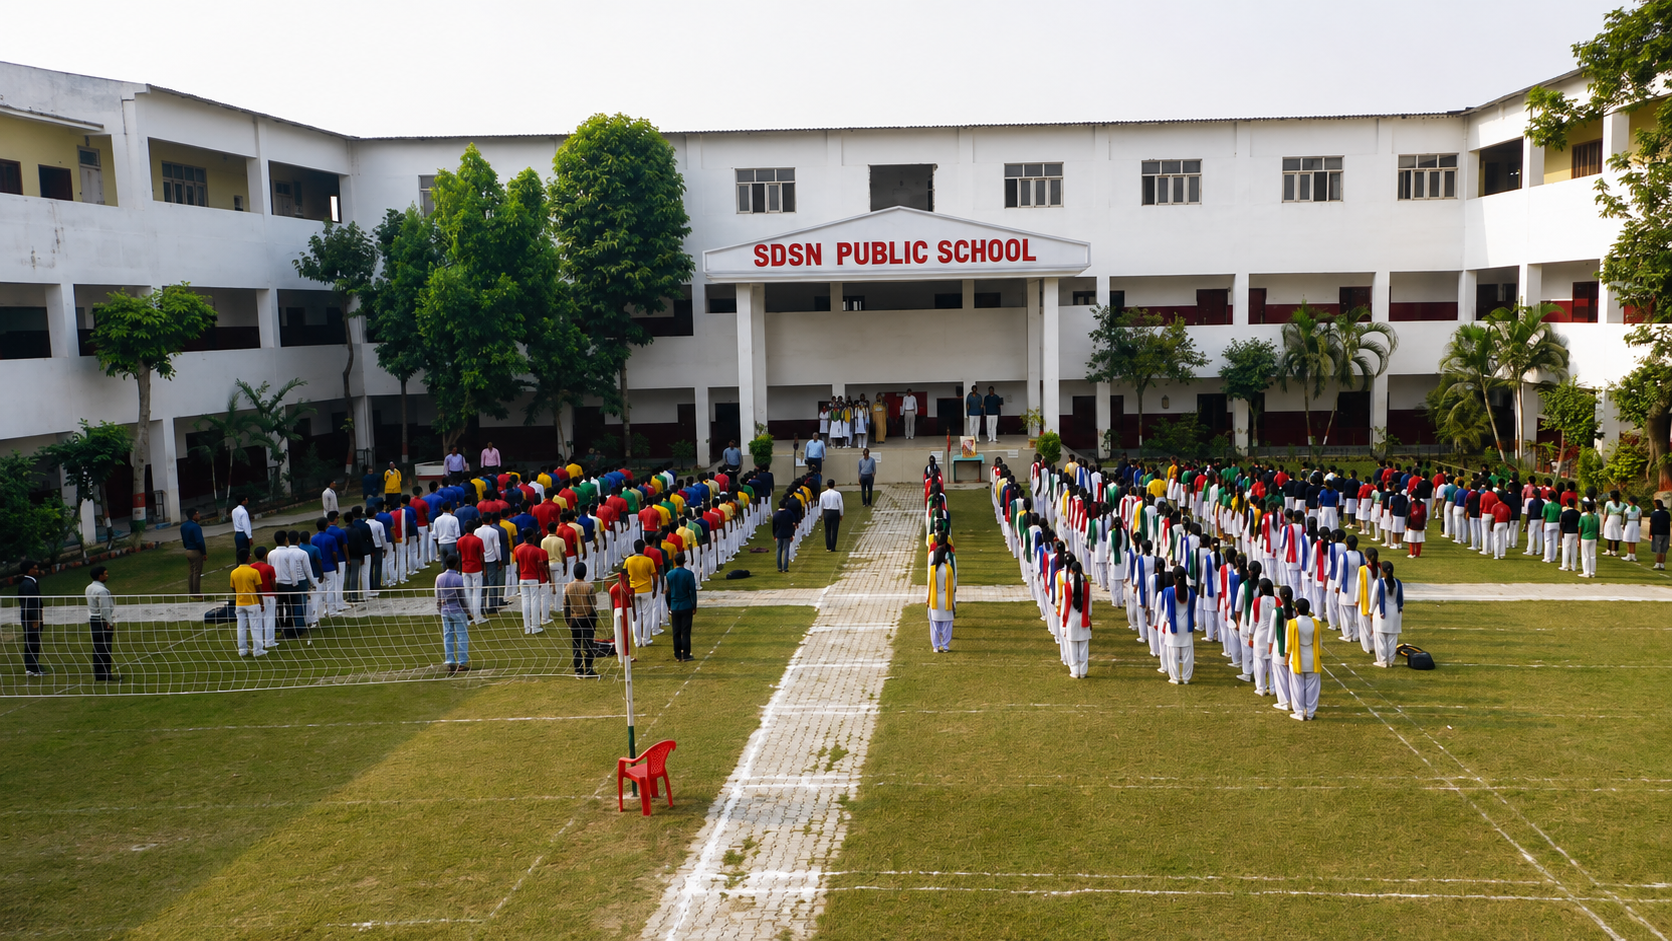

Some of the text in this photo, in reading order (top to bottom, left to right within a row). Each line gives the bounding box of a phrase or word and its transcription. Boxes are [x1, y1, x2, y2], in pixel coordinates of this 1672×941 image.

[753, 238, 1037, 267] SDSN PUBLIC SCHOOL
